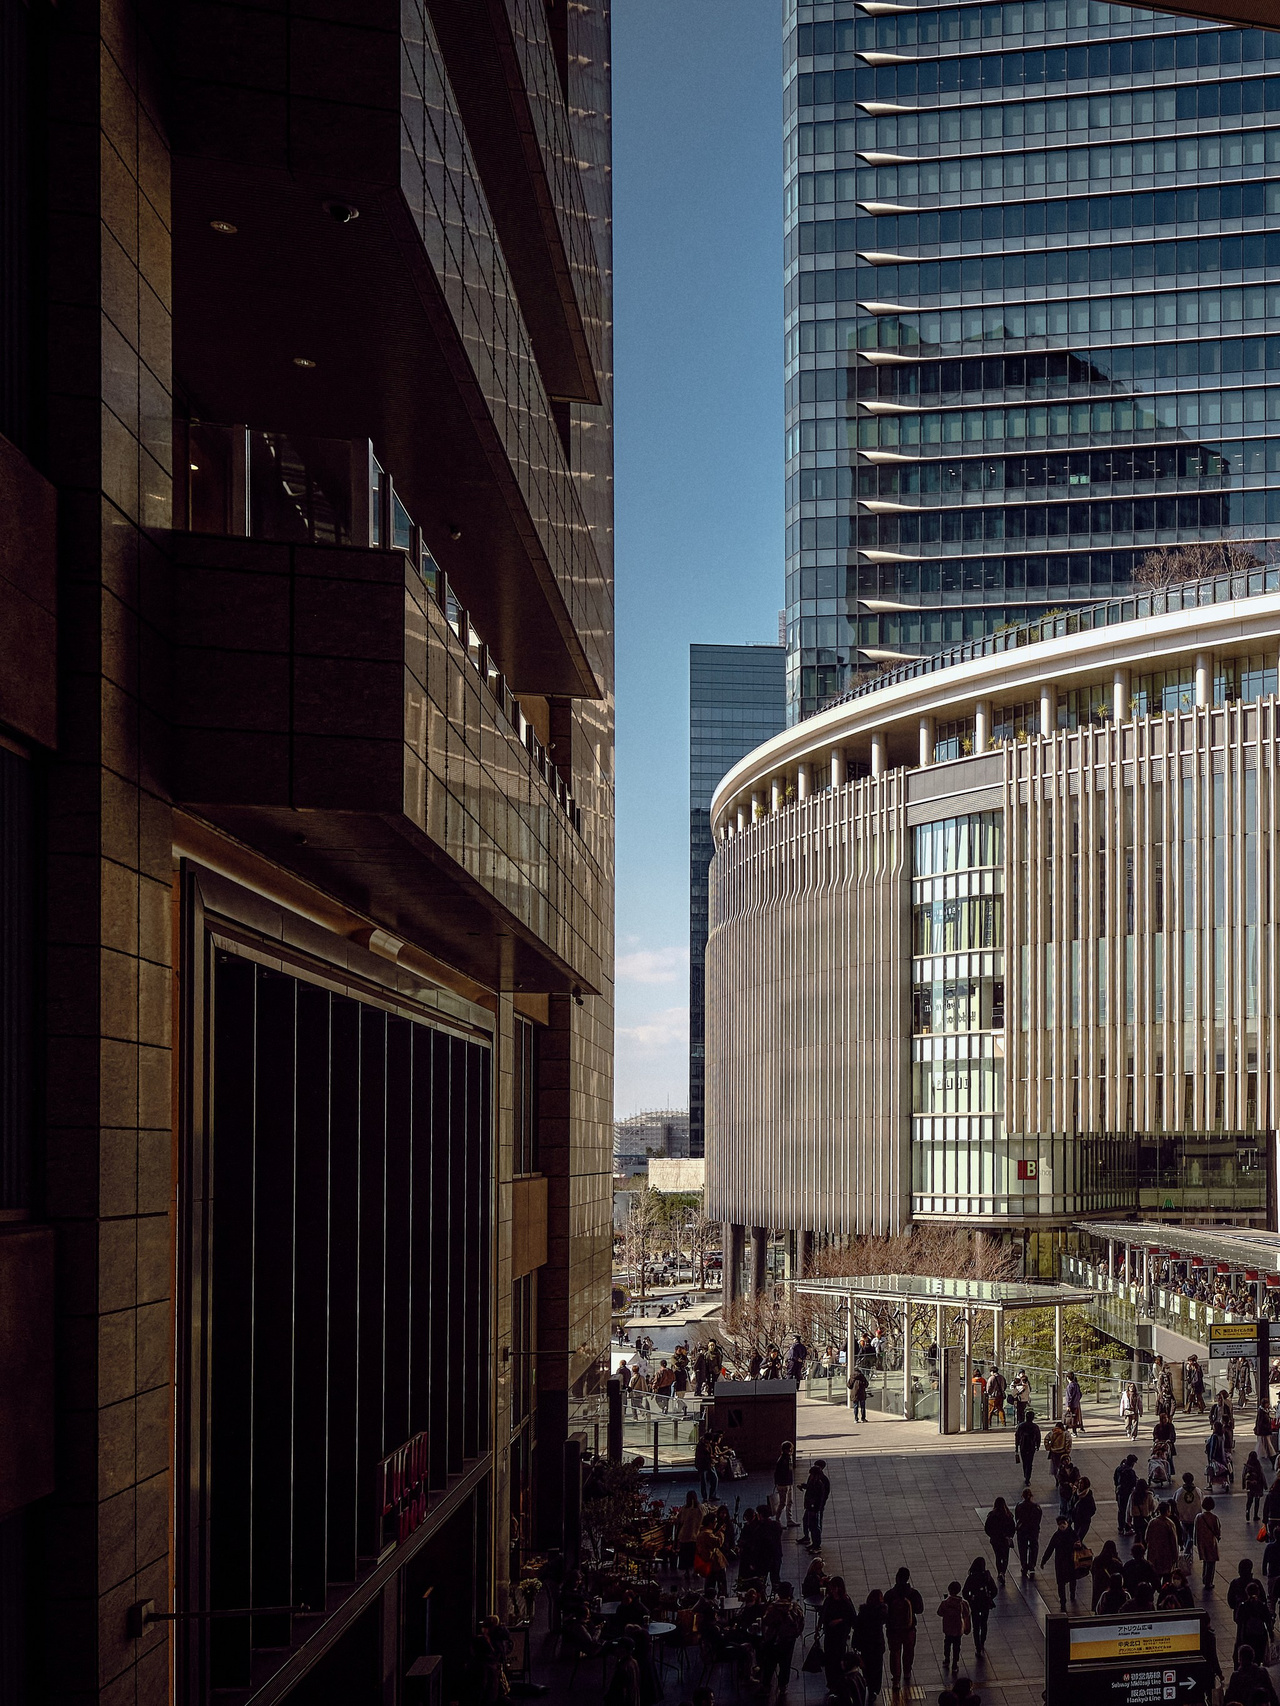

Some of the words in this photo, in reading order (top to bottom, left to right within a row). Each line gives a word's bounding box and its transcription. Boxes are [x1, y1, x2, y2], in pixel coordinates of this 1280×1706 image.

[1118, 1624, 1152, 1632] アトリウム広場
[1130, 1687, 1161, 1698] 阪急電車
